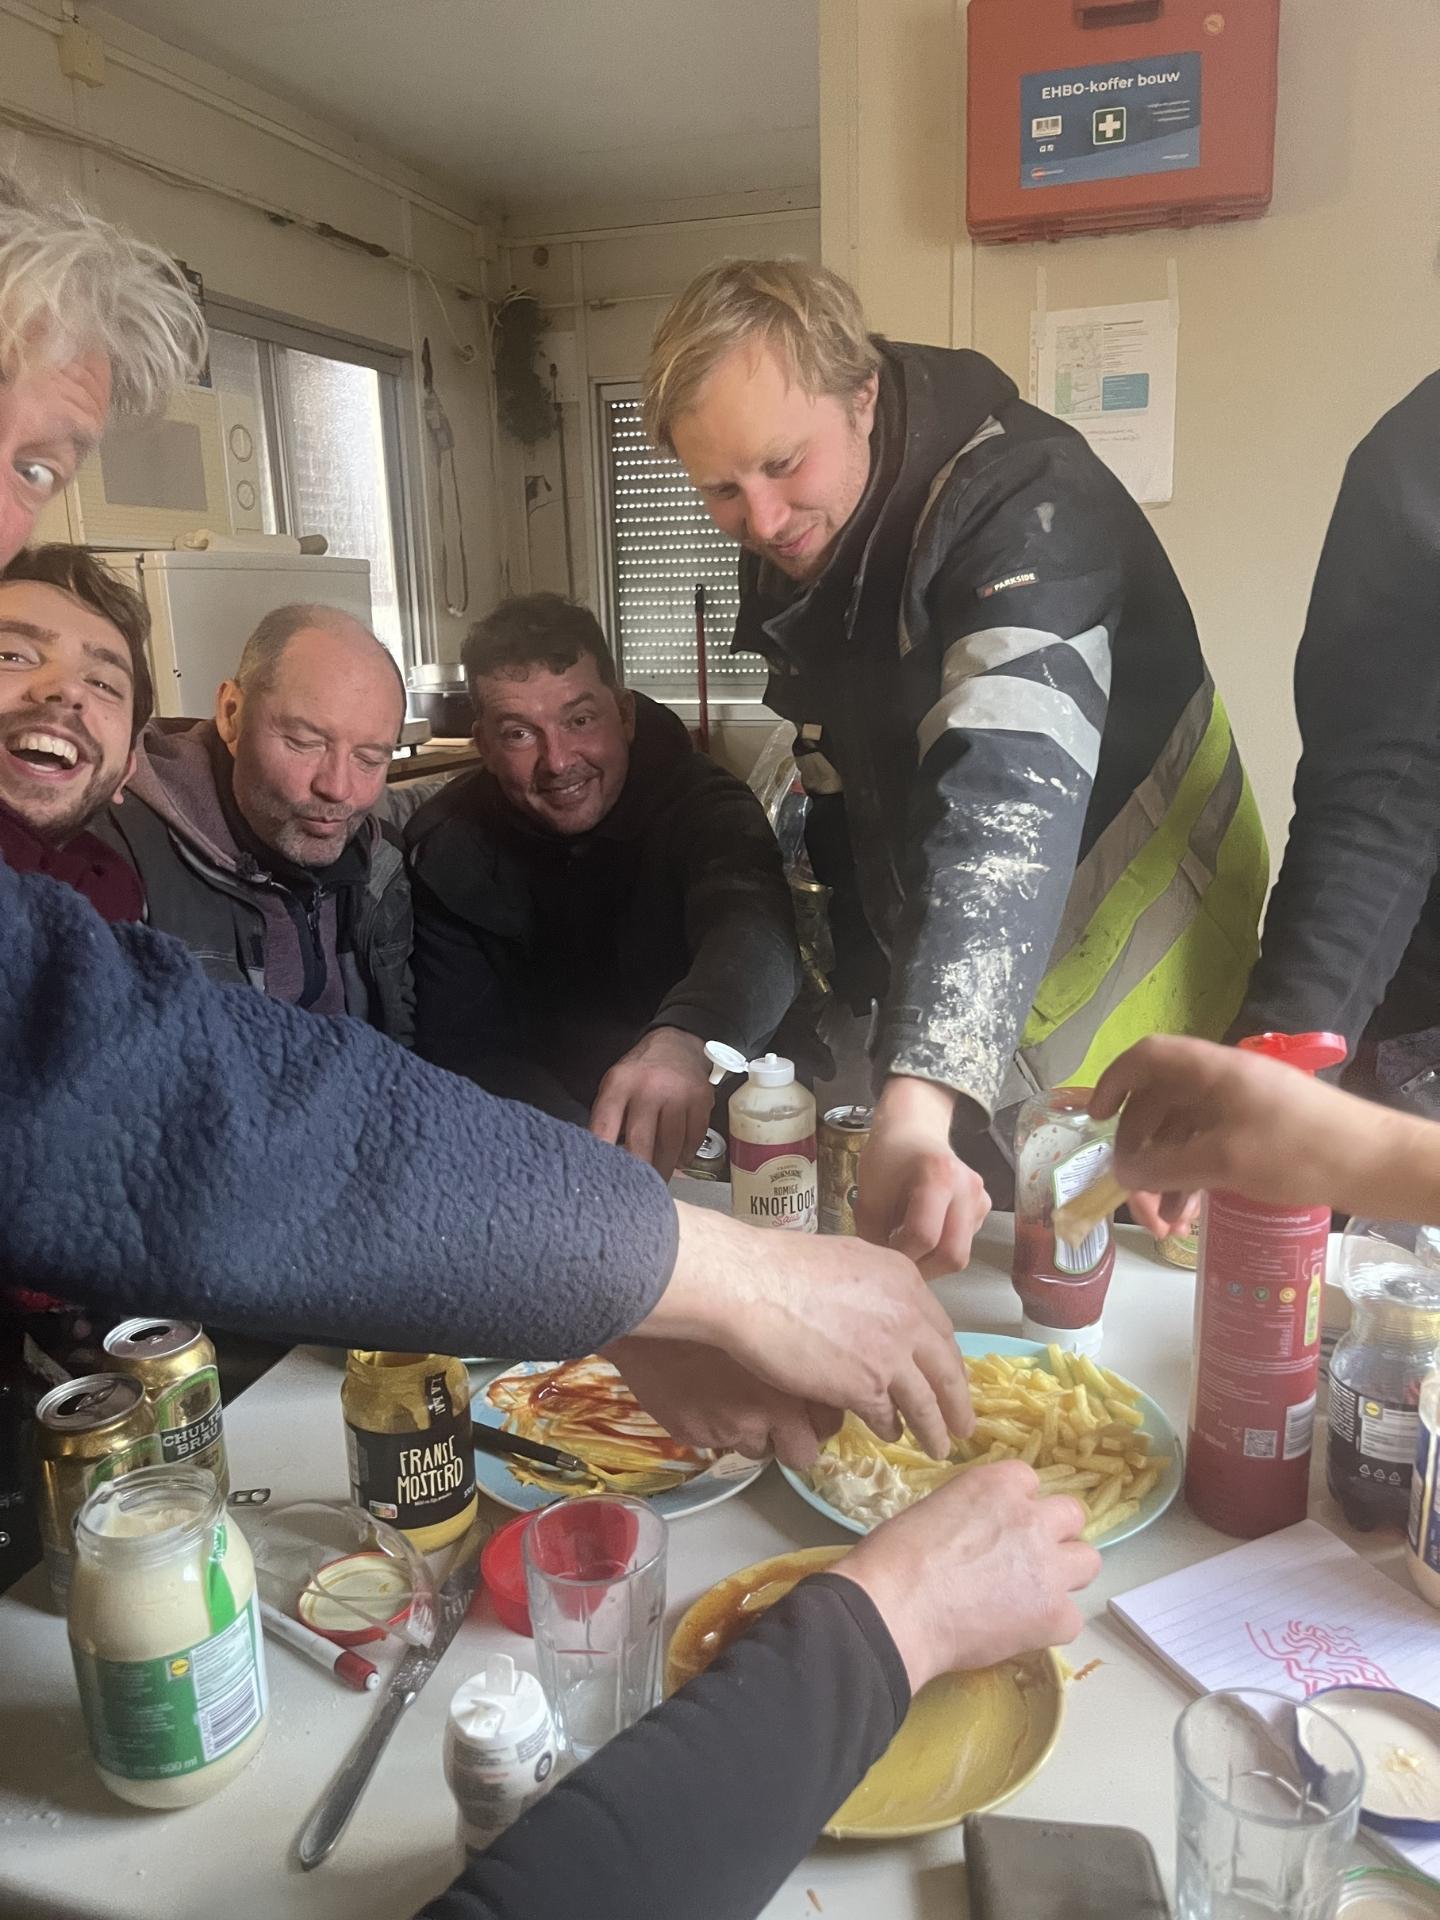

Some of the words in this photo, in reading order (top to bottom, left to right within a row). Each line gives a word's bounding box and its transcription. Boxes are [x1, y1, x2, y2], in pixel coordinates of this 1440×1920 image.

[1041, 77, 1134, 99] EHBO-koffer
[1138, 72, 1180, 86] bouw
[993, 573, 1036, 591] PARKSIDE
[750, 1185, 815, 1217] KNOFLOOK
[400, 1435, 456, 1476] FRANSE
[397, 1457, 463, 1504] MOSTERD
